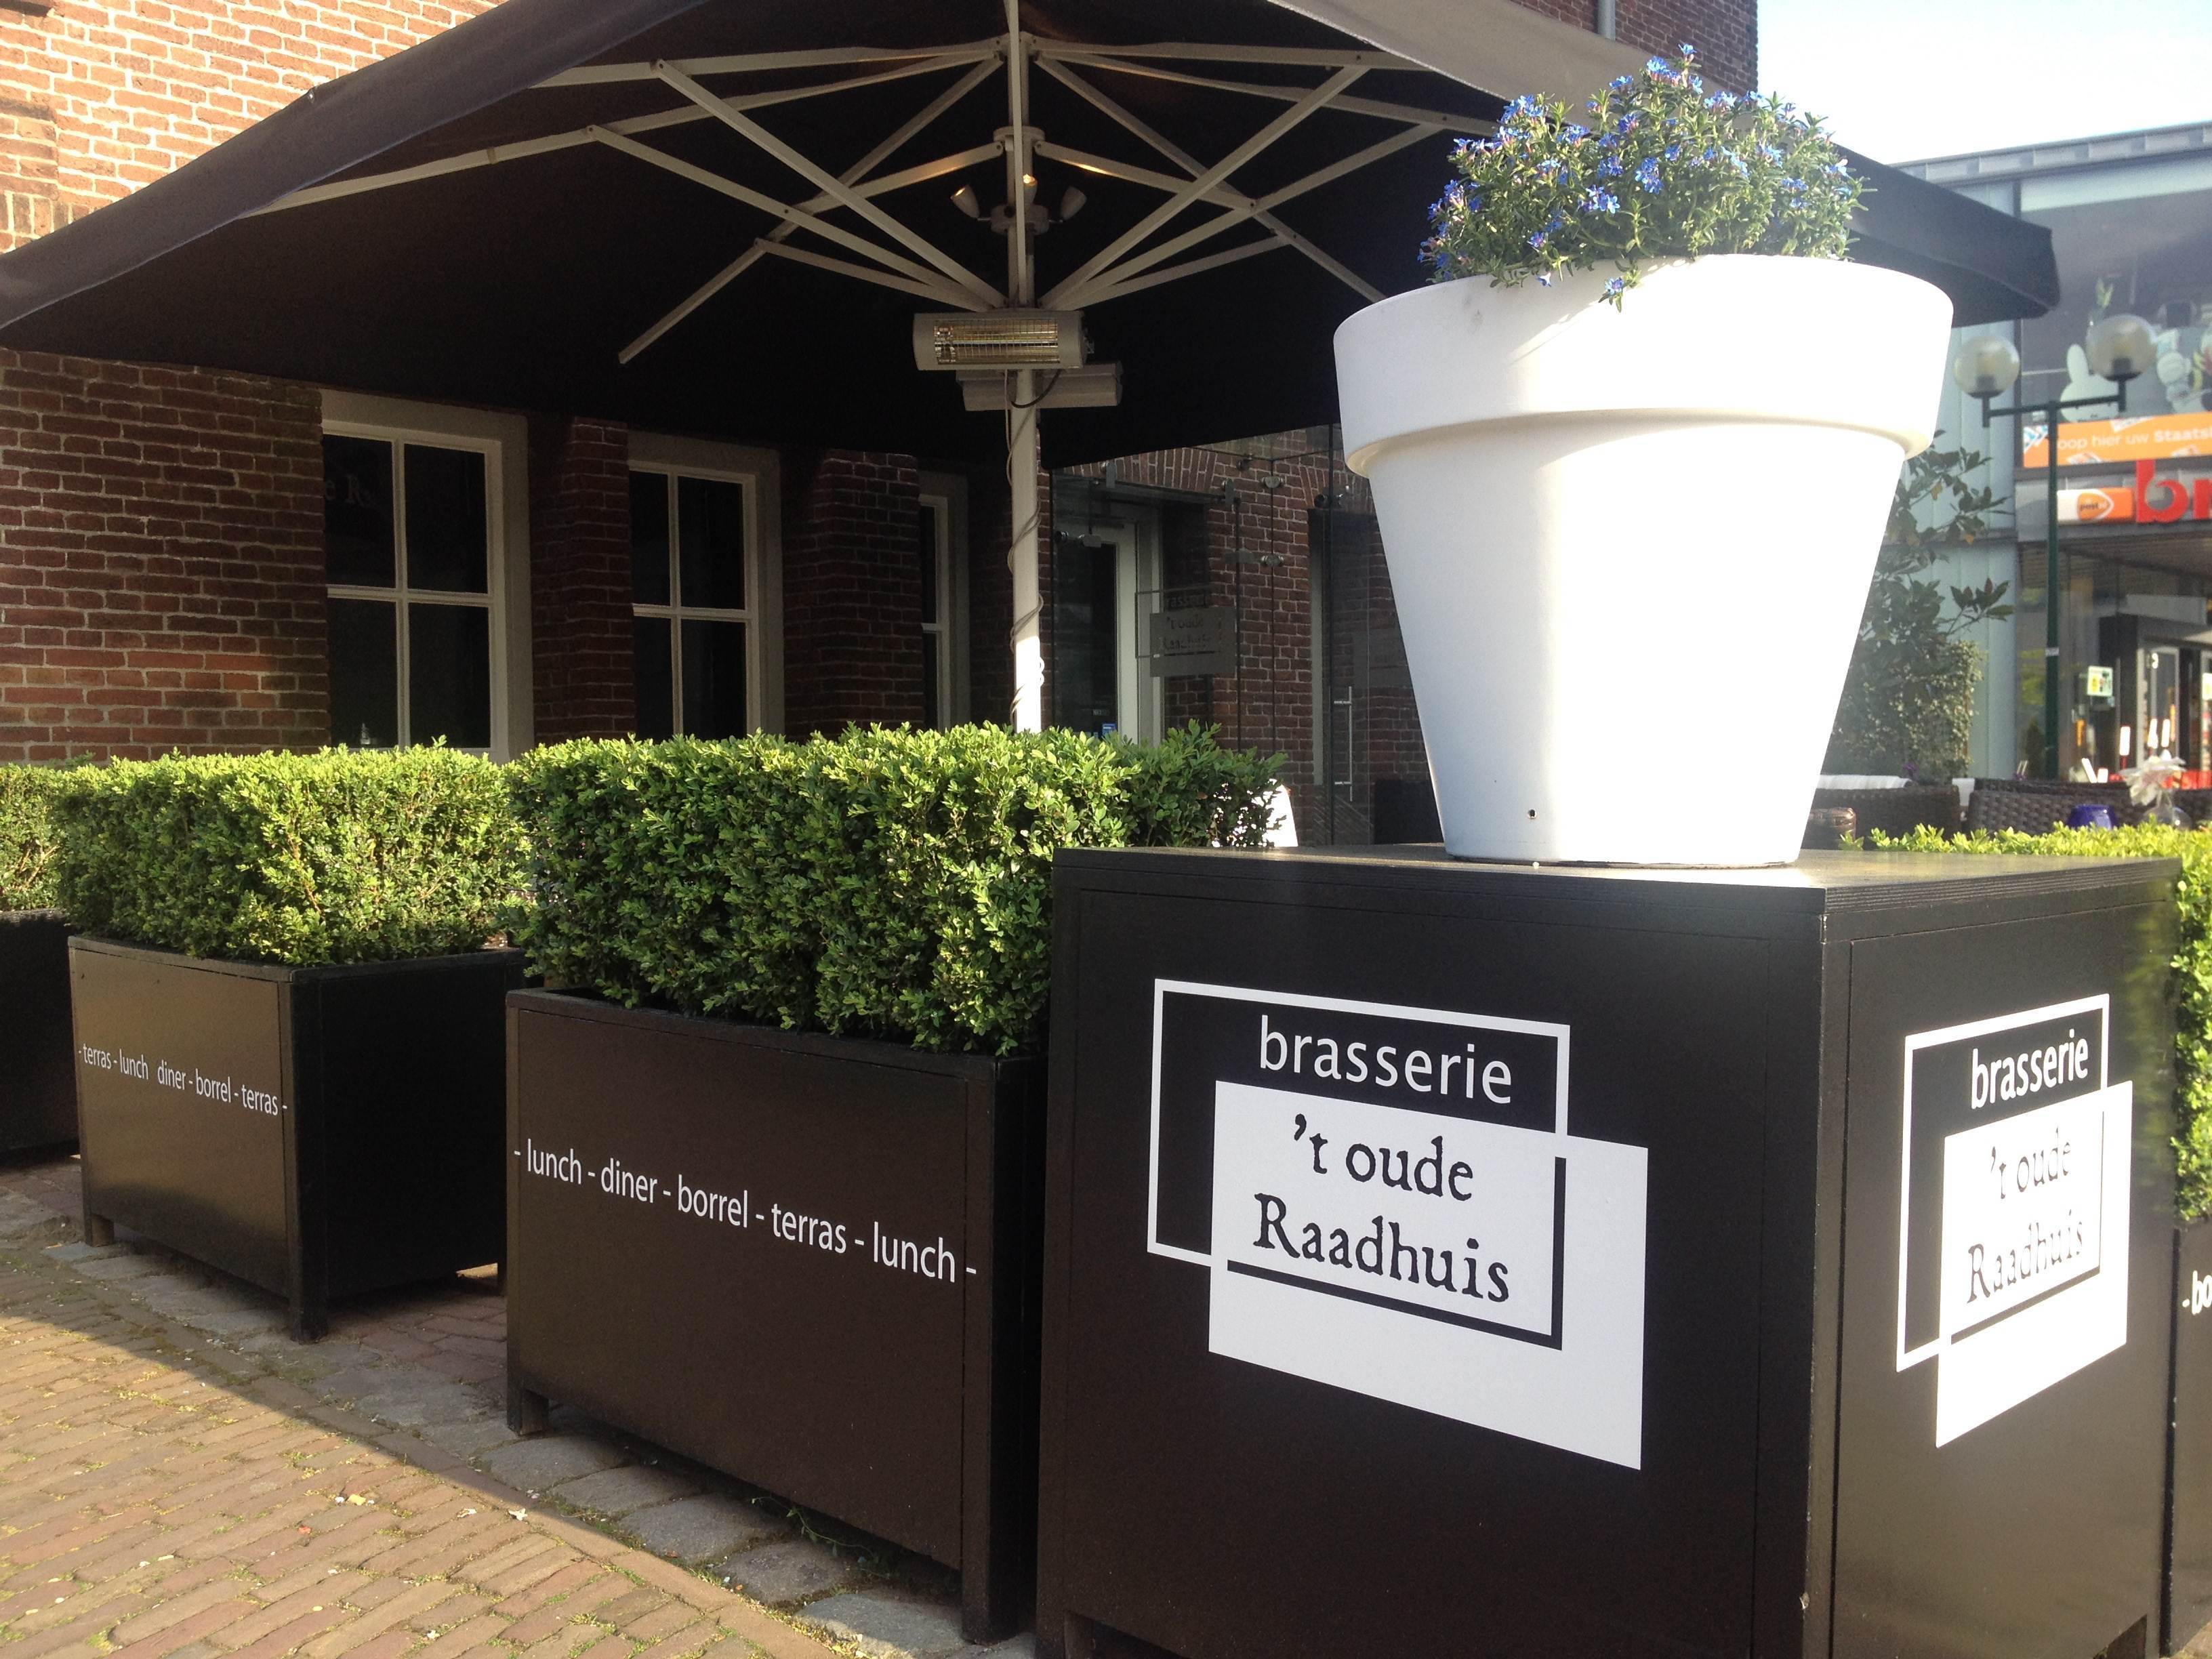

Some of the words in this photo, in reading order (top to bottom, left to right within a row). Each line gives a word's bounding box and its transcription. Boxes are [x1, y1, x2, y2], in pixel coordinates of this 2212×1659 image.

[2057, 437, 2088, 450] oop
[2092, 435, 2121, 447] hier
[2125, 434, 2149, 445] uw
[83, 1043, 112, 1070] terras
[119, 1048, 149, 1080] lunch
[157, 1059, 186, 1090] diner
[195, 1068, 231, 1103] borrel
[241, 1084, 279, 1116] terras
[1260, 1015, 1511, 1104] brasserie
[1970, 1028, 2089, 1109] brasserie
[1294, 1113, 1328, 1174] 't
[1345, 1135, 1473, 1202] oude
[2016, 1126, 2071, 1193] oude
[527, 1138, 581, 1185] lunch
[600, 1158, 658, 1204] diner
[678, 1174, 748, 1228] borrel
[771, 1203, 846, 1254] terras
[874, 1221, 956, 1283] lunch
[1253, 1193, 1510, 1303] Raadhuis
[1966, 1208, 2083, 1304] Raadhuis
